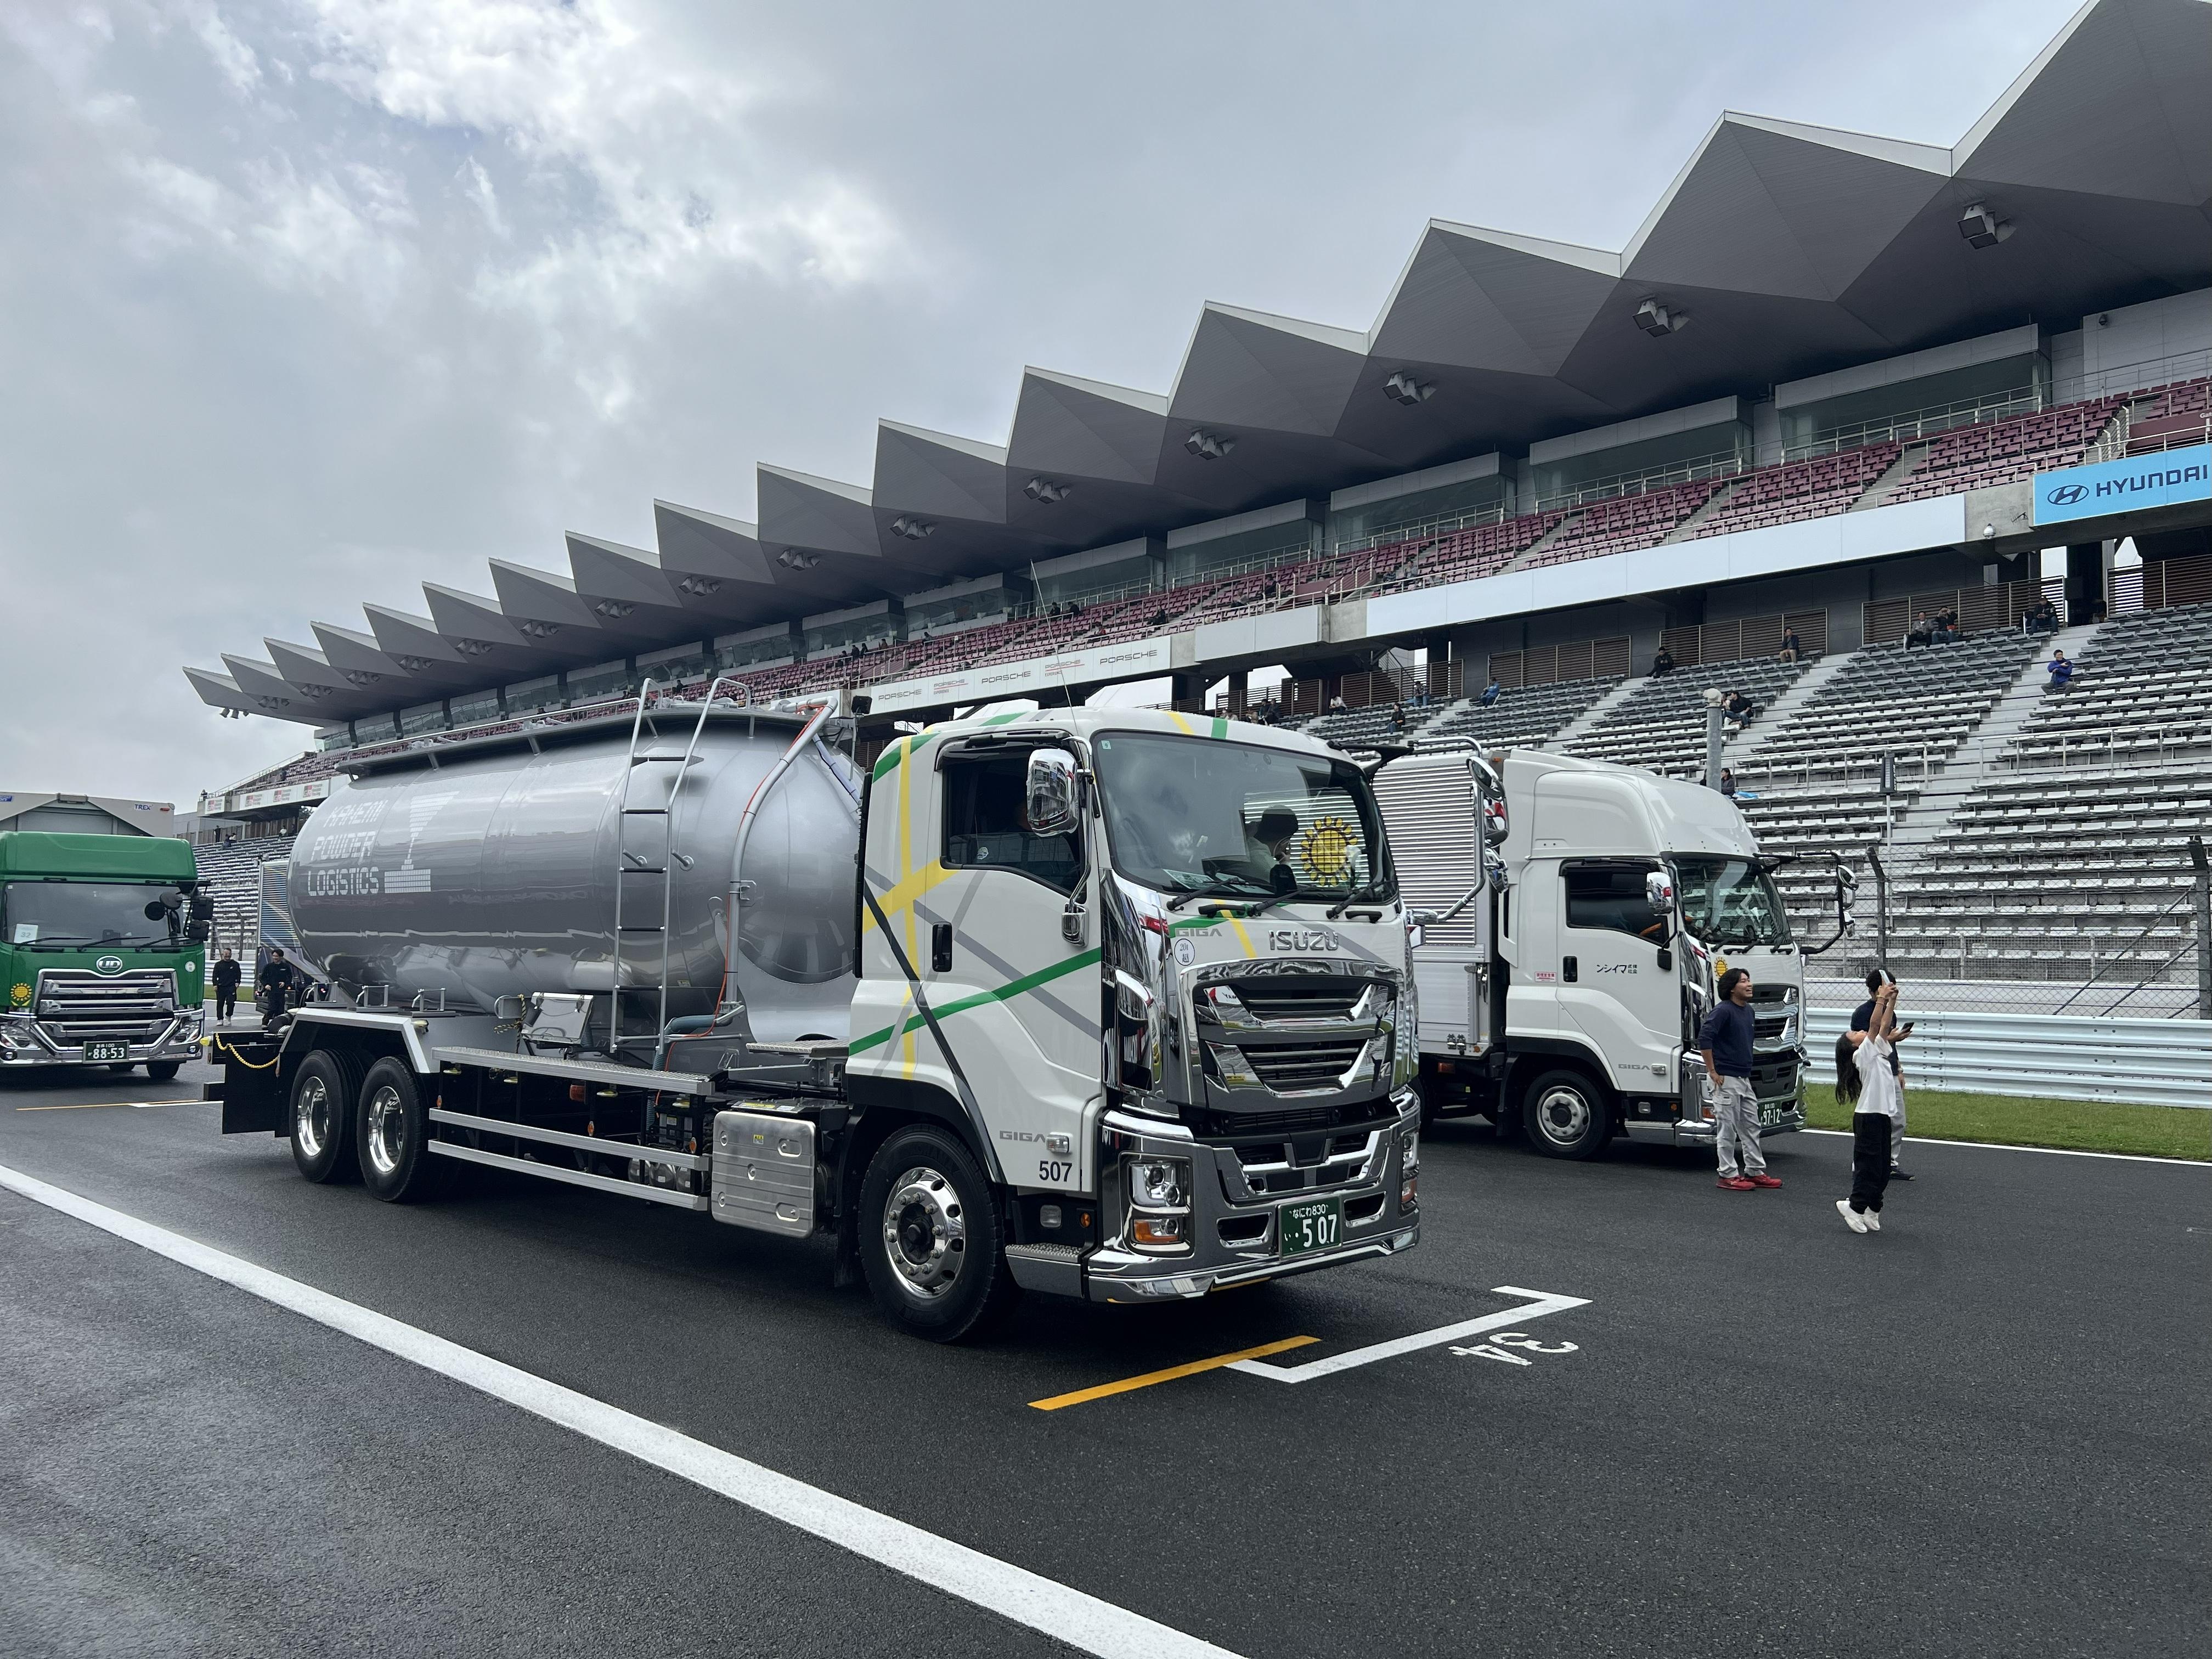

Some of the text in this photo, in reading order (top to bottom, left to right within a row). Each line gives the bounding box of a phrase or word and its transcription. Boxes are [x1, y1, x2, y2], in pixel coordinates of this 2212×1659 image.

[2096, 465, 2208, 497] HYUNDAI
[1045, 659, 1081, 669] PORSCHE
[1100, 650, 1158, 665] PORSCHE
[934, 679, 966, 688] PORSCHE
[981, 670, 1031, 685] PORSCHE
[878, 689, 922, 701] PORSCHE
[311, 831, 376, 861] POWDER
[308, 866, 379, 896] LOGISTICS
[1175, 927, 1222, 937] GIGA
[1268, 930, 1339, 951] ISUZU
[98, 960, 121, 968] UD
[93, 1047, 125, 1059] 88-53
[1000, 1130, 1046, 1142] GIGA
[1039, 1160, 1073, 1182] 507
[1448, 1332, 1579, 1366] 34
